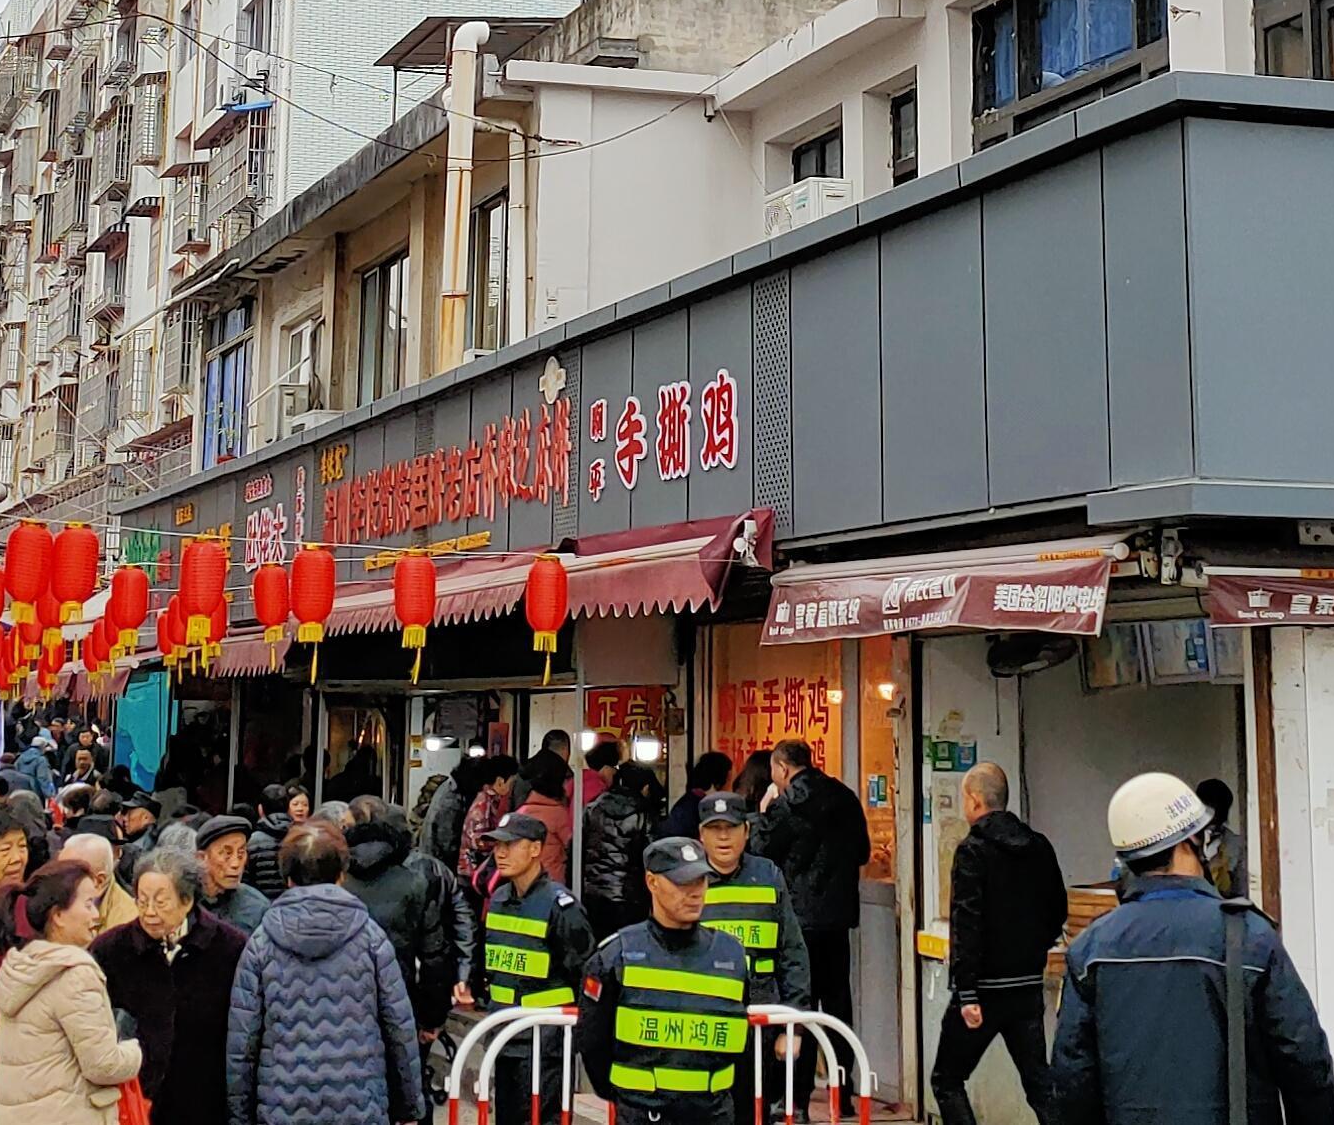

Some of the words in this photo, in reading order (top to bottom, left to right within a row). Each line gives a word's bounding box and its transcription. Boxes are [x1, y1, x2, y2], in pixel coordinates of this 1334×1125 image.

[615, 368, 739, 490] 手撕鸡
[638, 1015, 731, 1048] 温州鸿盾
